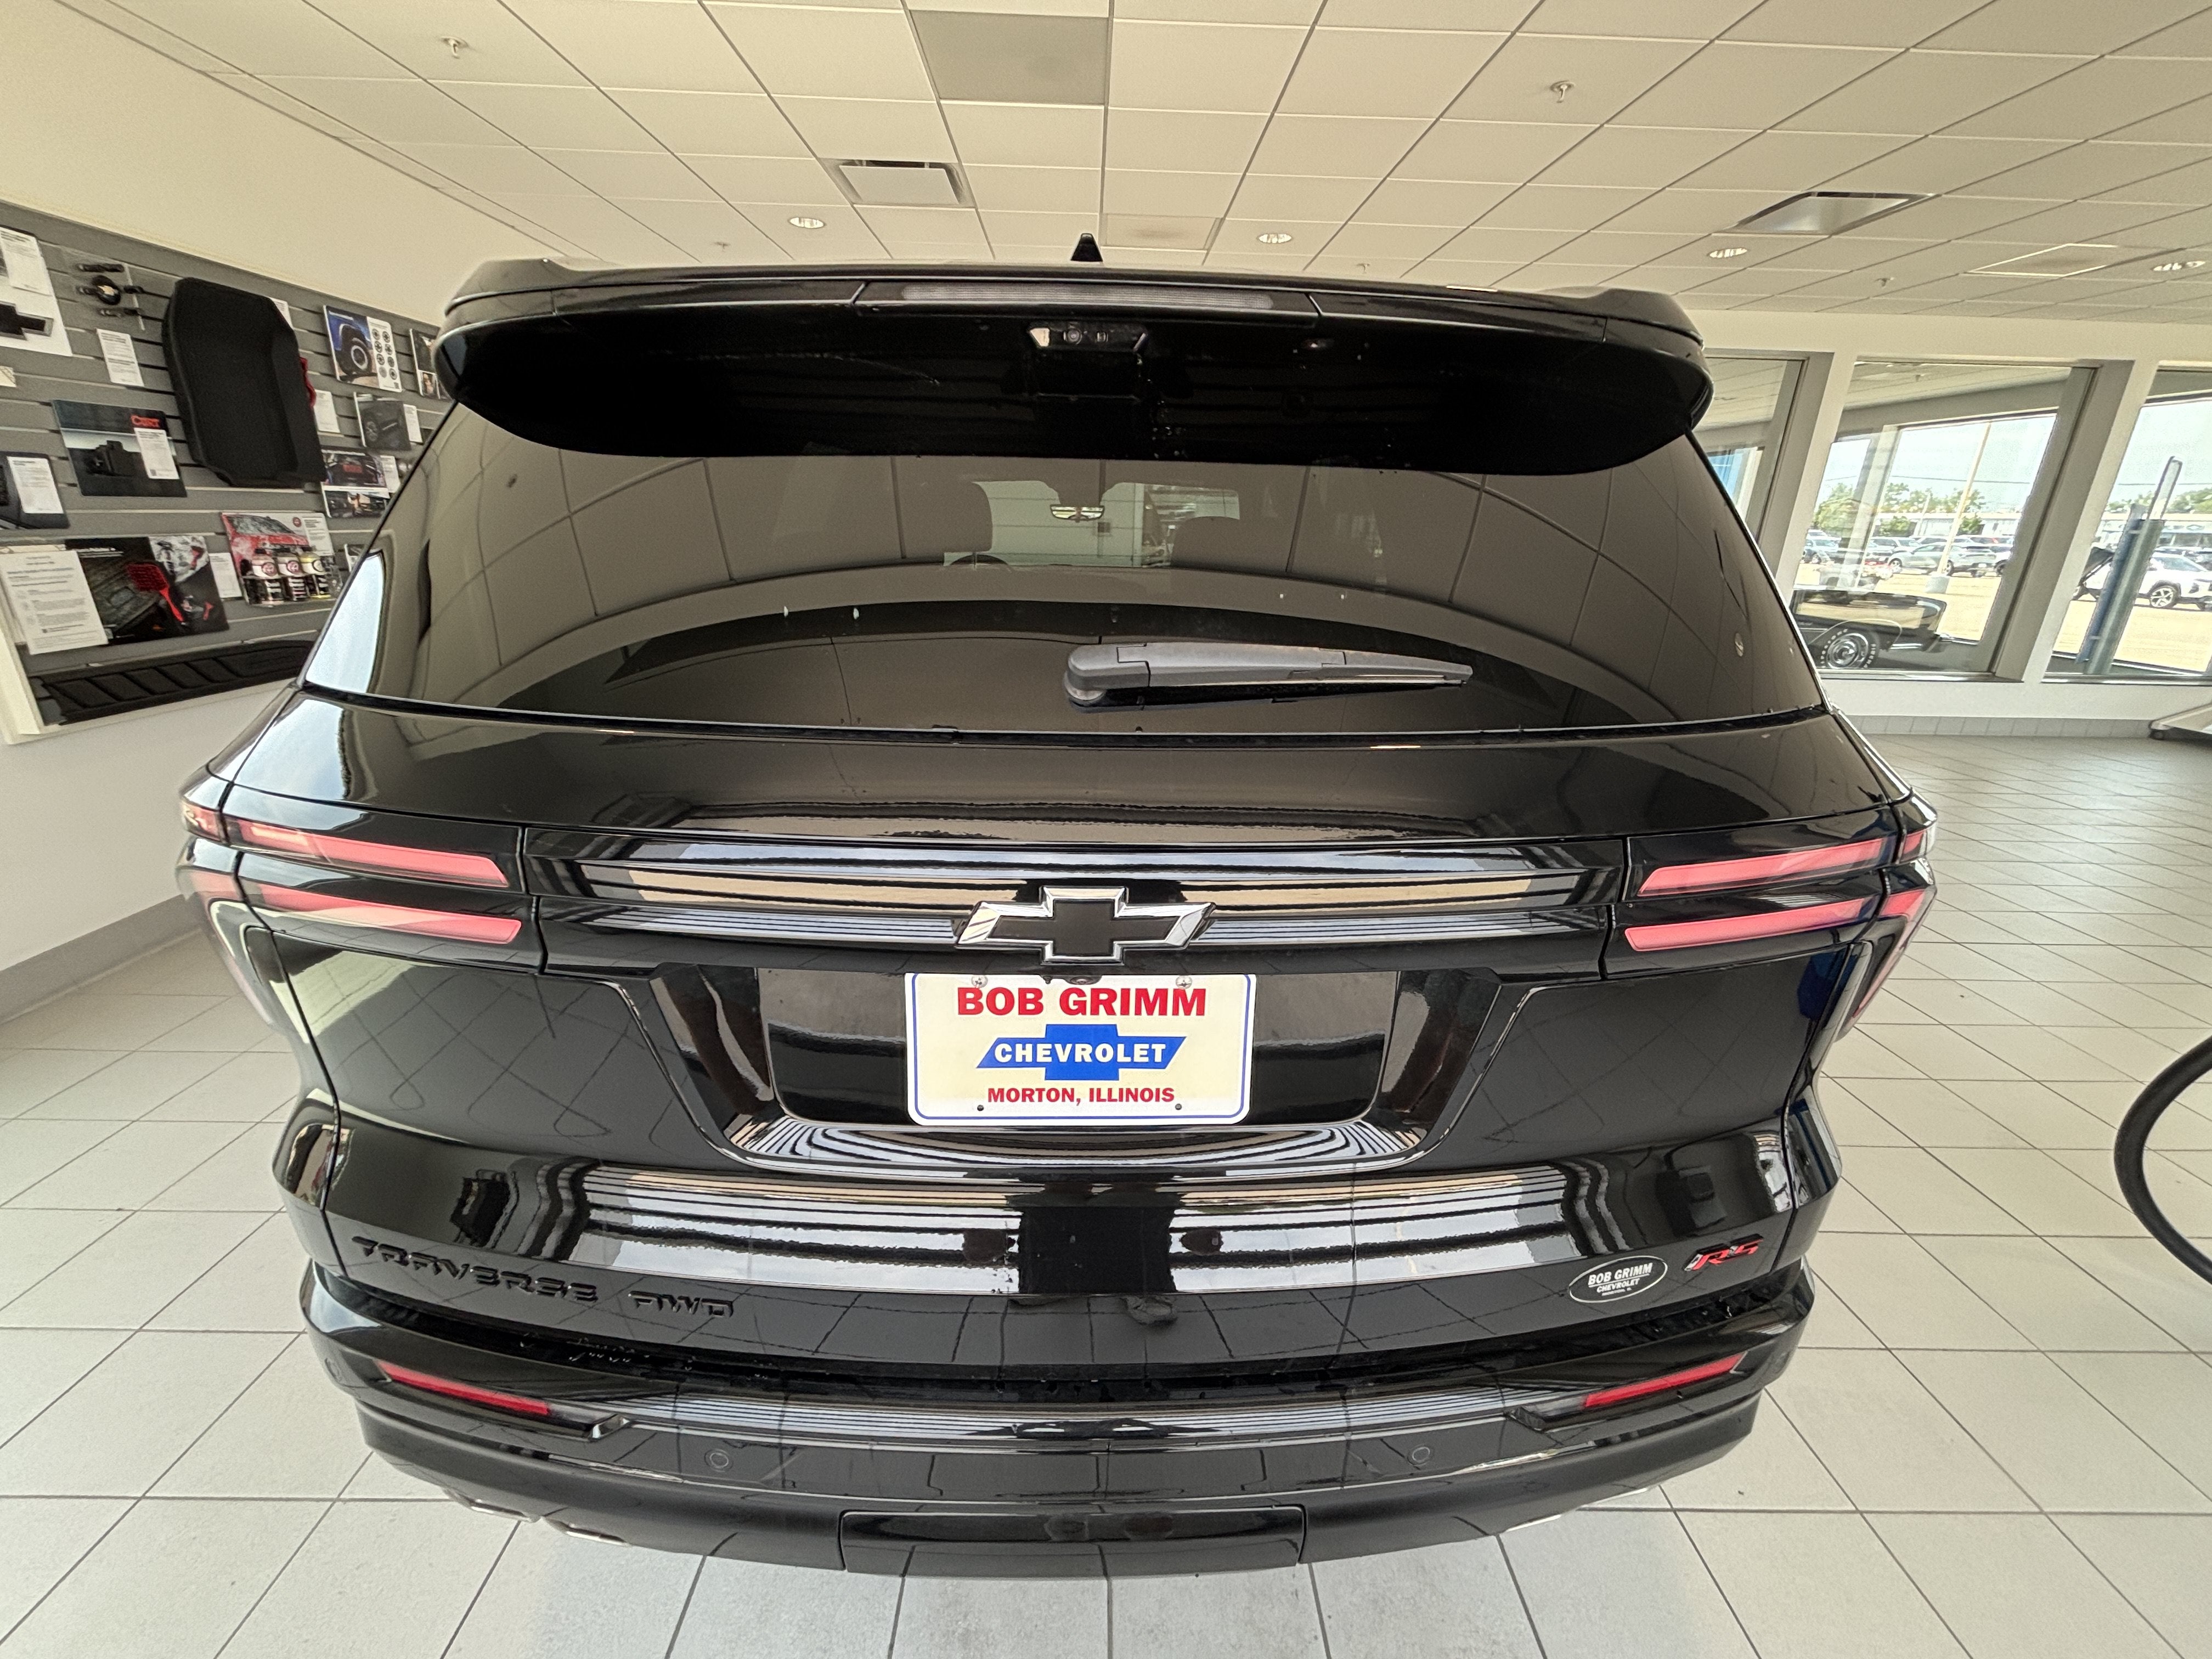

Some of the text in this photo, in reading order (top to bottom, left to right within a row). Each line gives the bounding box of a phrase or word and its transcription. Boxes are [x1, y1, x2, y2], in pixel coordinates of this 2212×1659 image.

[957, 987, 1206, 1016] BOB GRIMM
[994, 1043, 1166, 1063] CHEVROLET
[988, 1087, 1175, 1106] MORTON, ILLINOIS
[1683, 1233, 1764, 1272] RS
[351, 1235, 735, 1318] TRAVERSE AWD
[1588, 1262, 1654, 1286] BOB GRIMM
[1596, 1278, 1640, 1294] CHEVROLET
